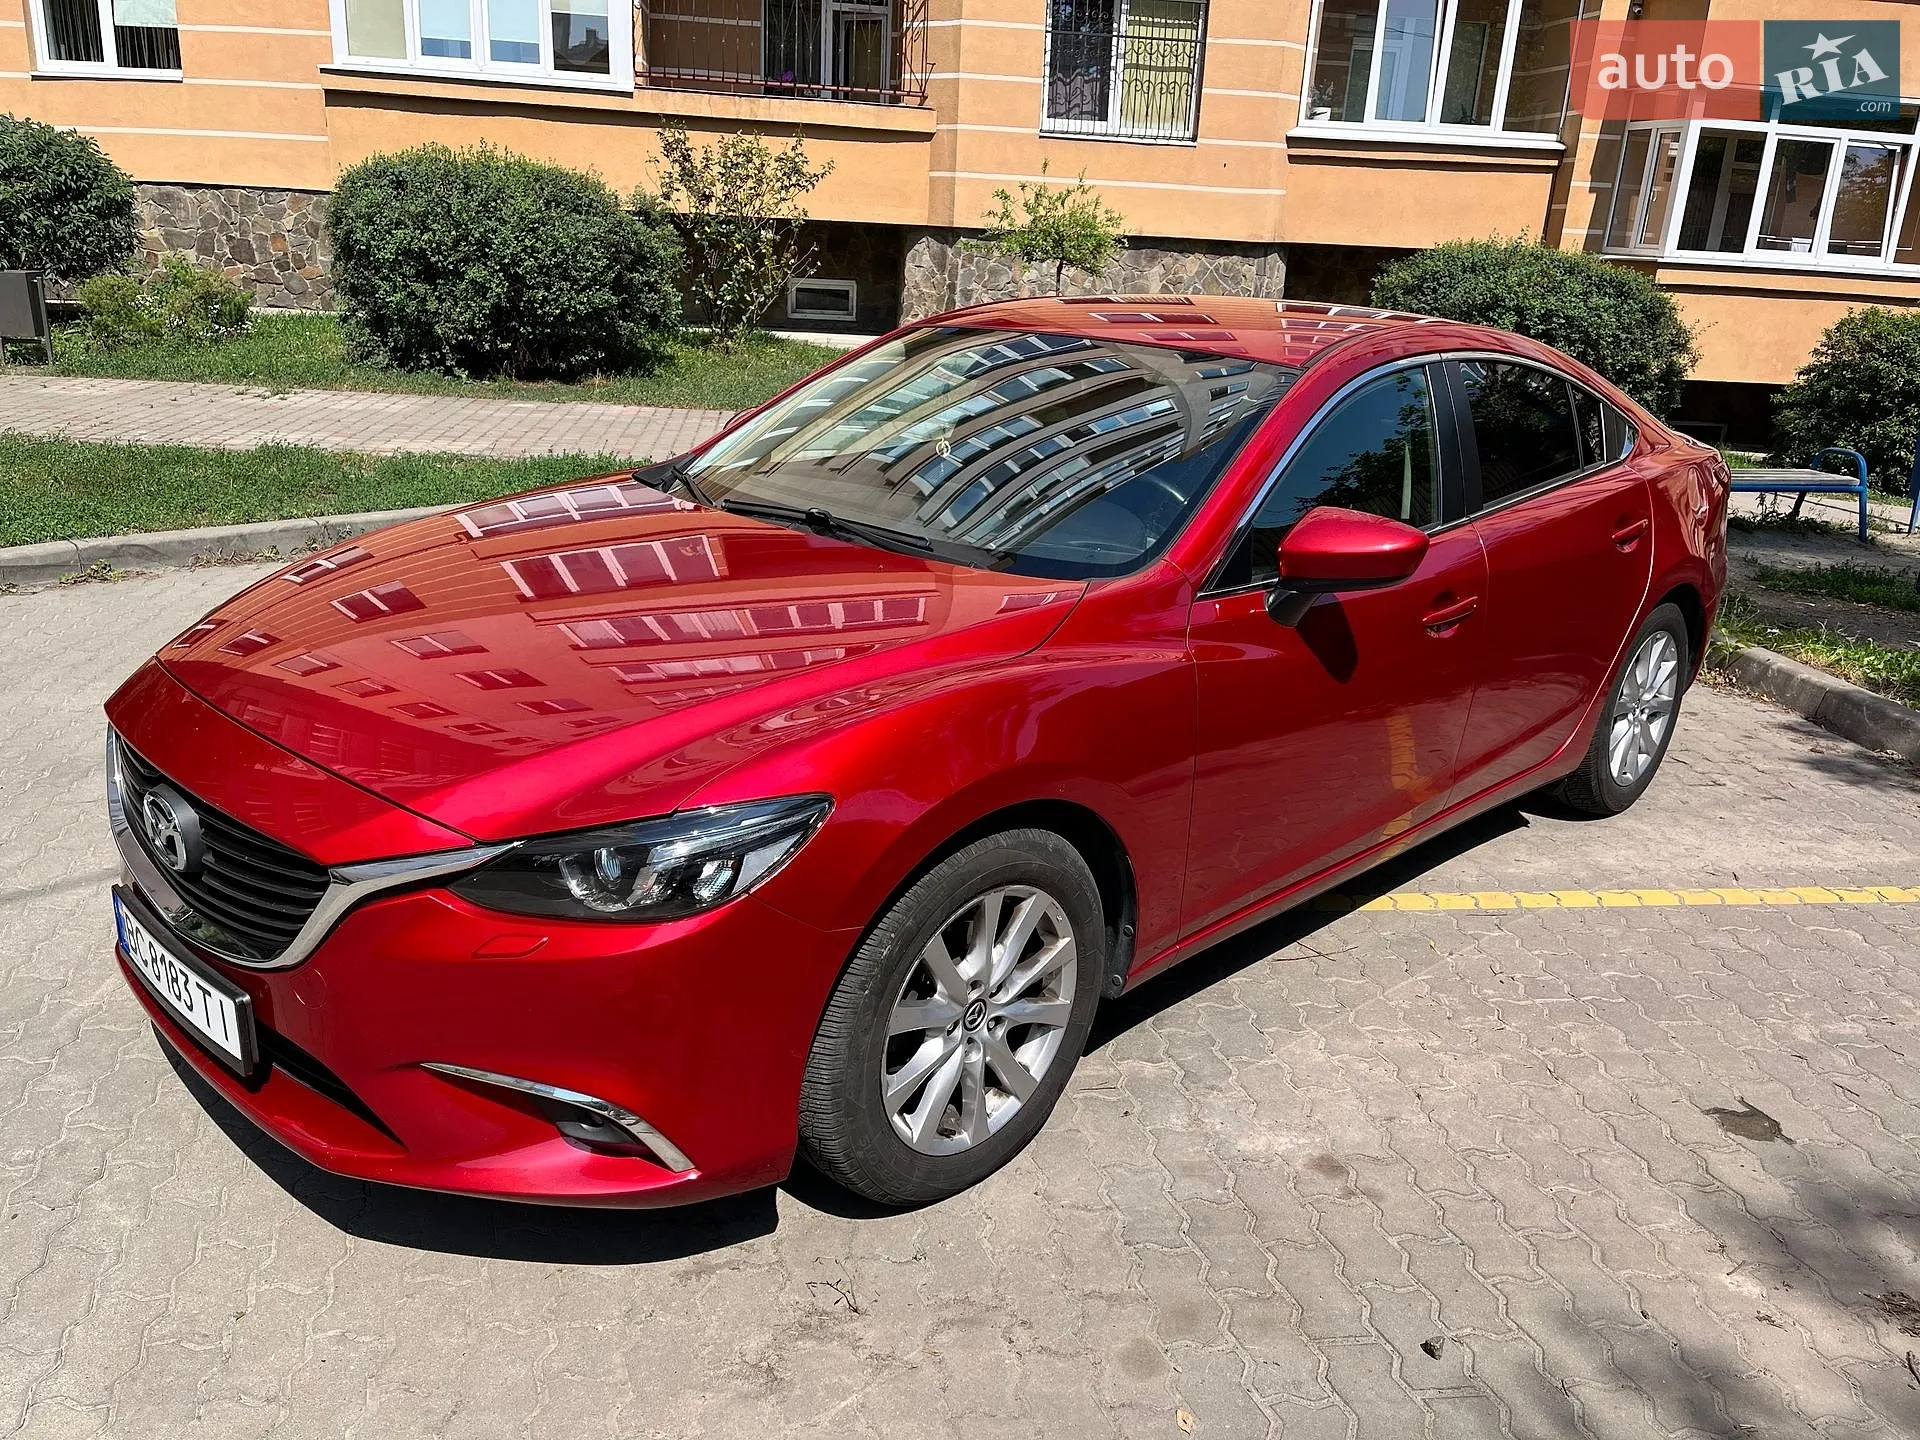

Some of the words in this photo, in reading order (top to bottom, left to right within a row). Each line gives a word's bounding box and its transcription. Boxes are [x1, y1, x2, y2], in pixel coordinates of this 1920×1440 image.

[125, 913, 148, 967] BC
[149, 941, 194, 1012] 8183
[196, 982, 229, 1042] TI
